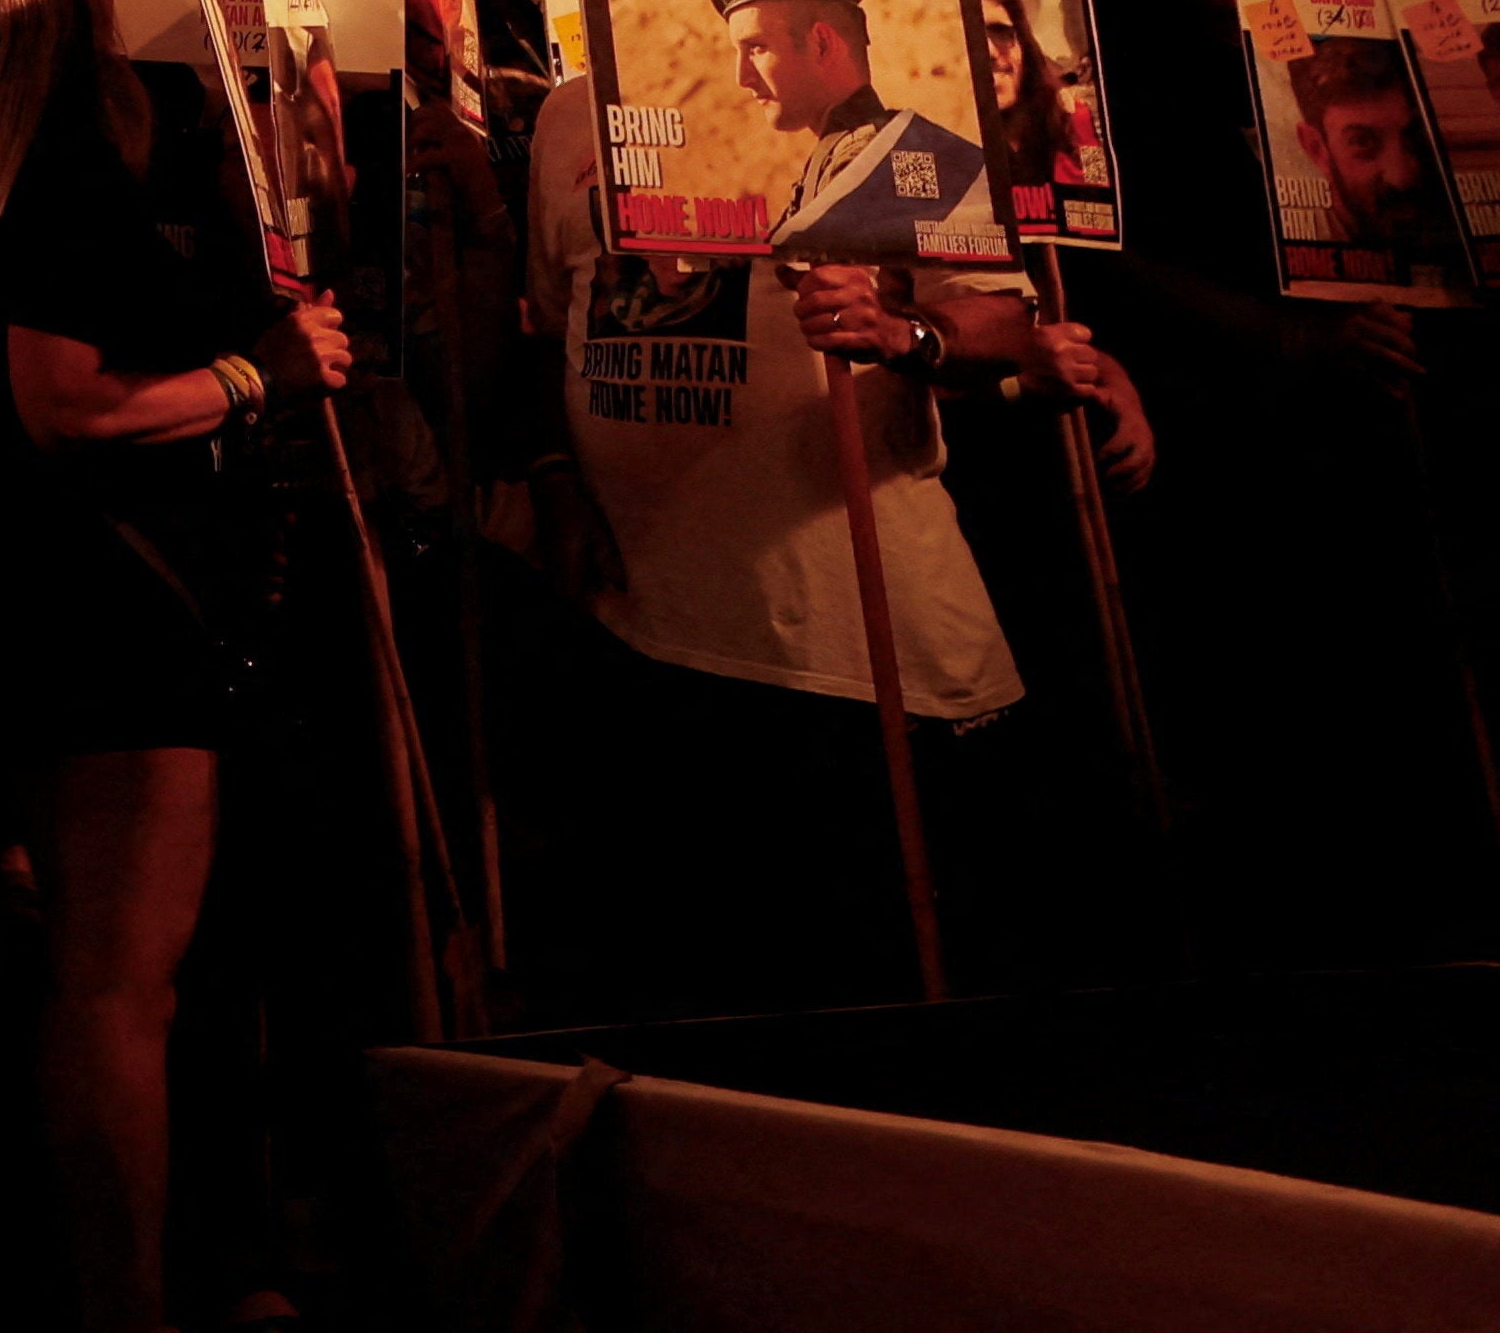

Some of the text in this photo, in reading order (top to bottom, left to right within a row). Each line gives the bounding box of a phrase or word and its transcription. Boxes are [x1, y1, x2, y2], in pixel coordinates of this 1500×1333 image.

[610, 106, 684, 146] BRING
[612, 147, 662, 188] HIM
[619, 193, 691, 238] HOME
[916, 234, 1009, 256] FAMILIES FORUM
[582, 345, 748, 382] BRING MATAN
[588, 388, 732, 427] HOME NOW!
